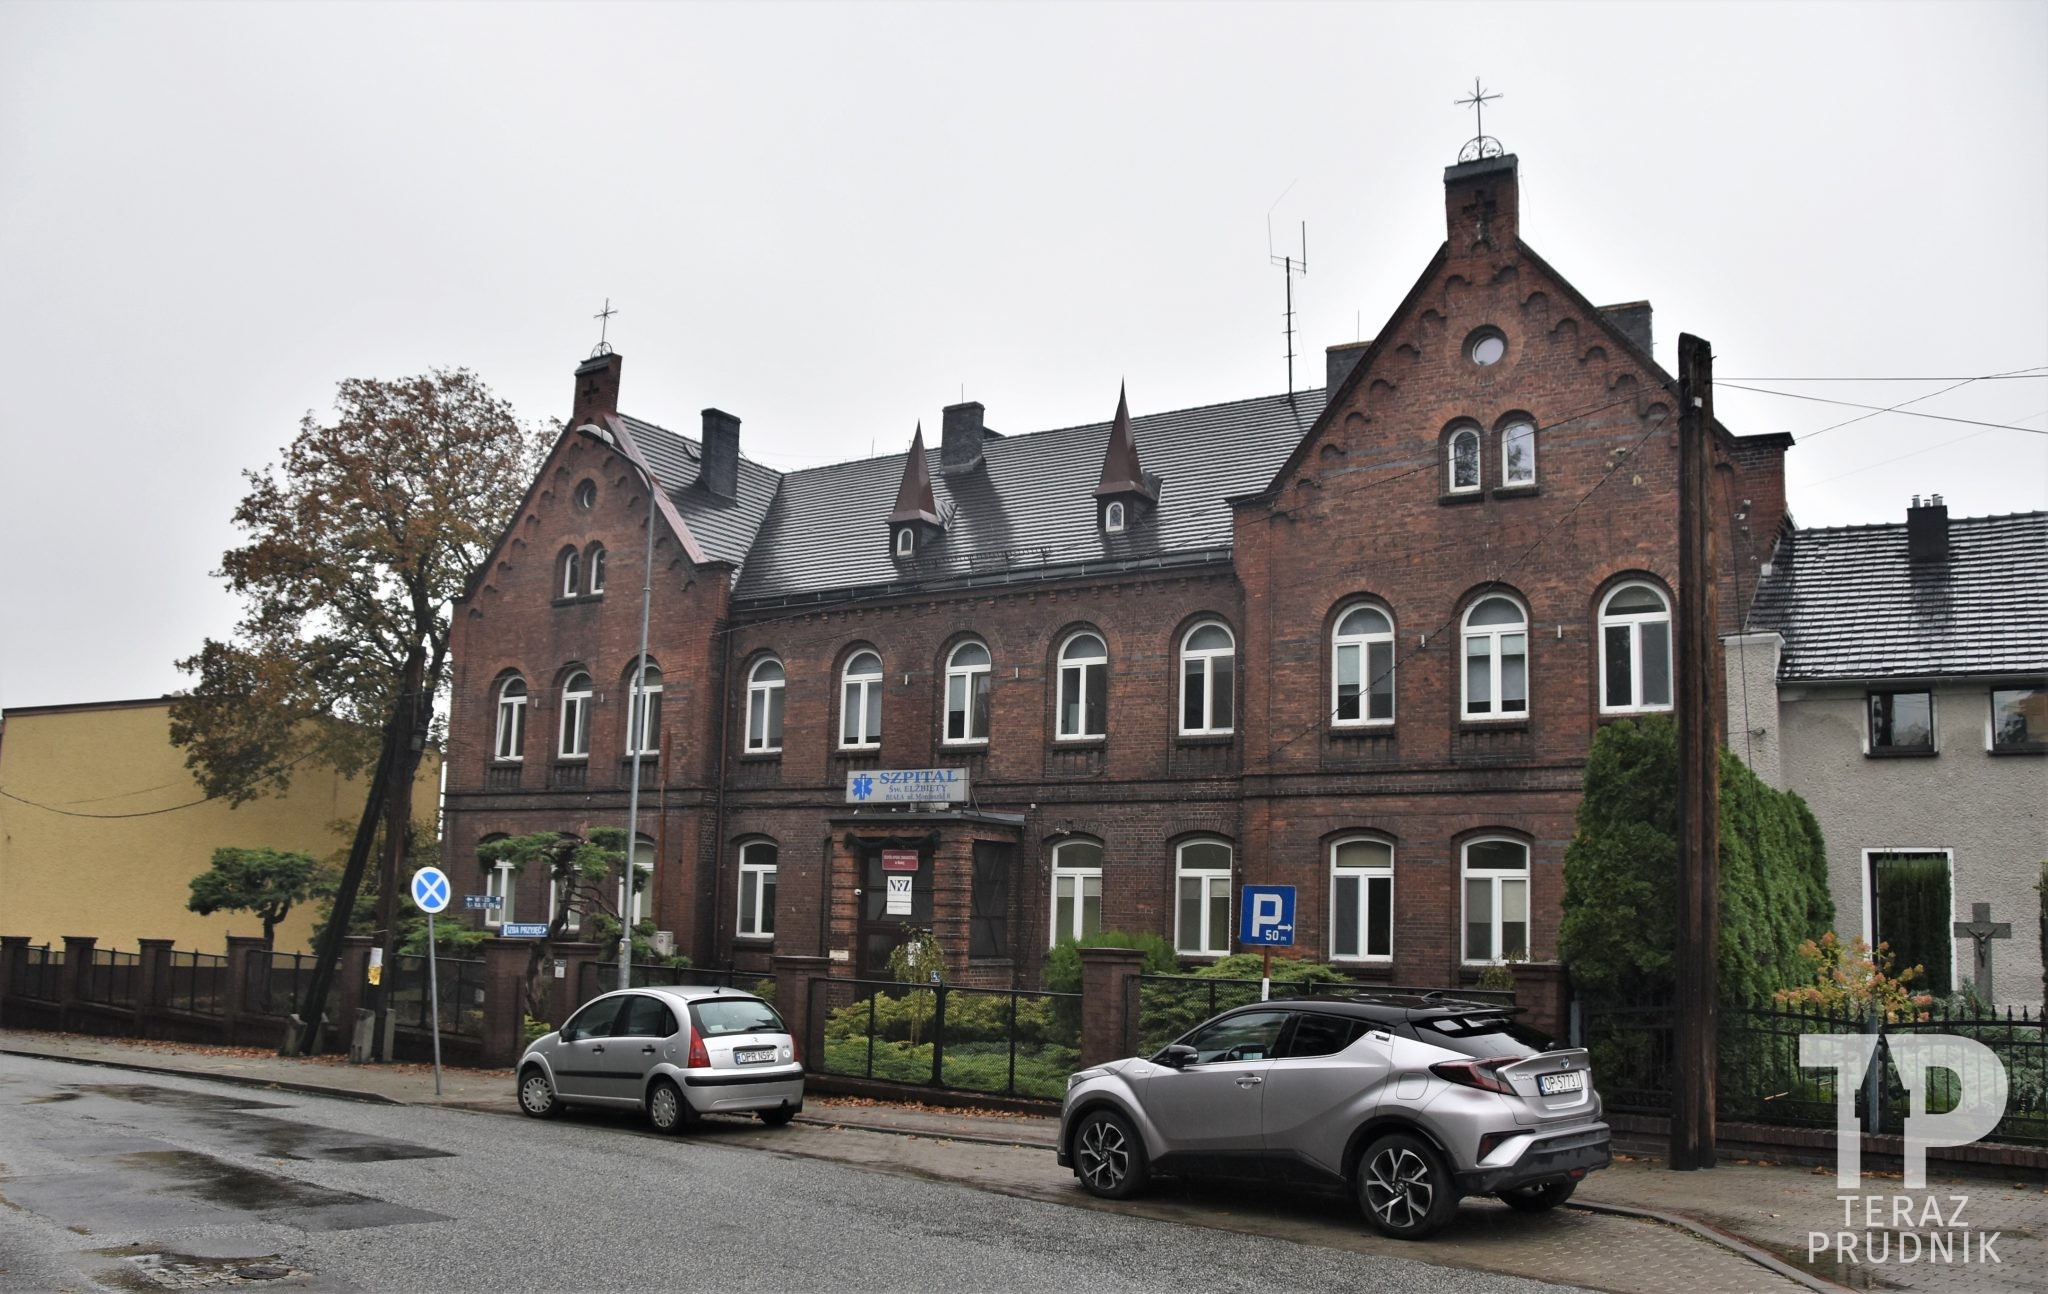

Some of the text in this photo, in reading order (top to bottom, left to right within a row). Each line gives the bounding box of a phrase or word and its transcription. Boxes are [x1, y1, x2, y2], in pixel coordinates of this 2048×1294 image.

[880, 770, 958, 784] SZPITAL
[904, 784, 948, 793] ELŻBIETY
[889, 880, 911, 892] NFZ
[1252, 893, 1283, 938] P
[507, 926, 519, 934] IZBA
[1265, 930, 1279, 941] 50
[1545, 1076, 1556, 1090] OP
